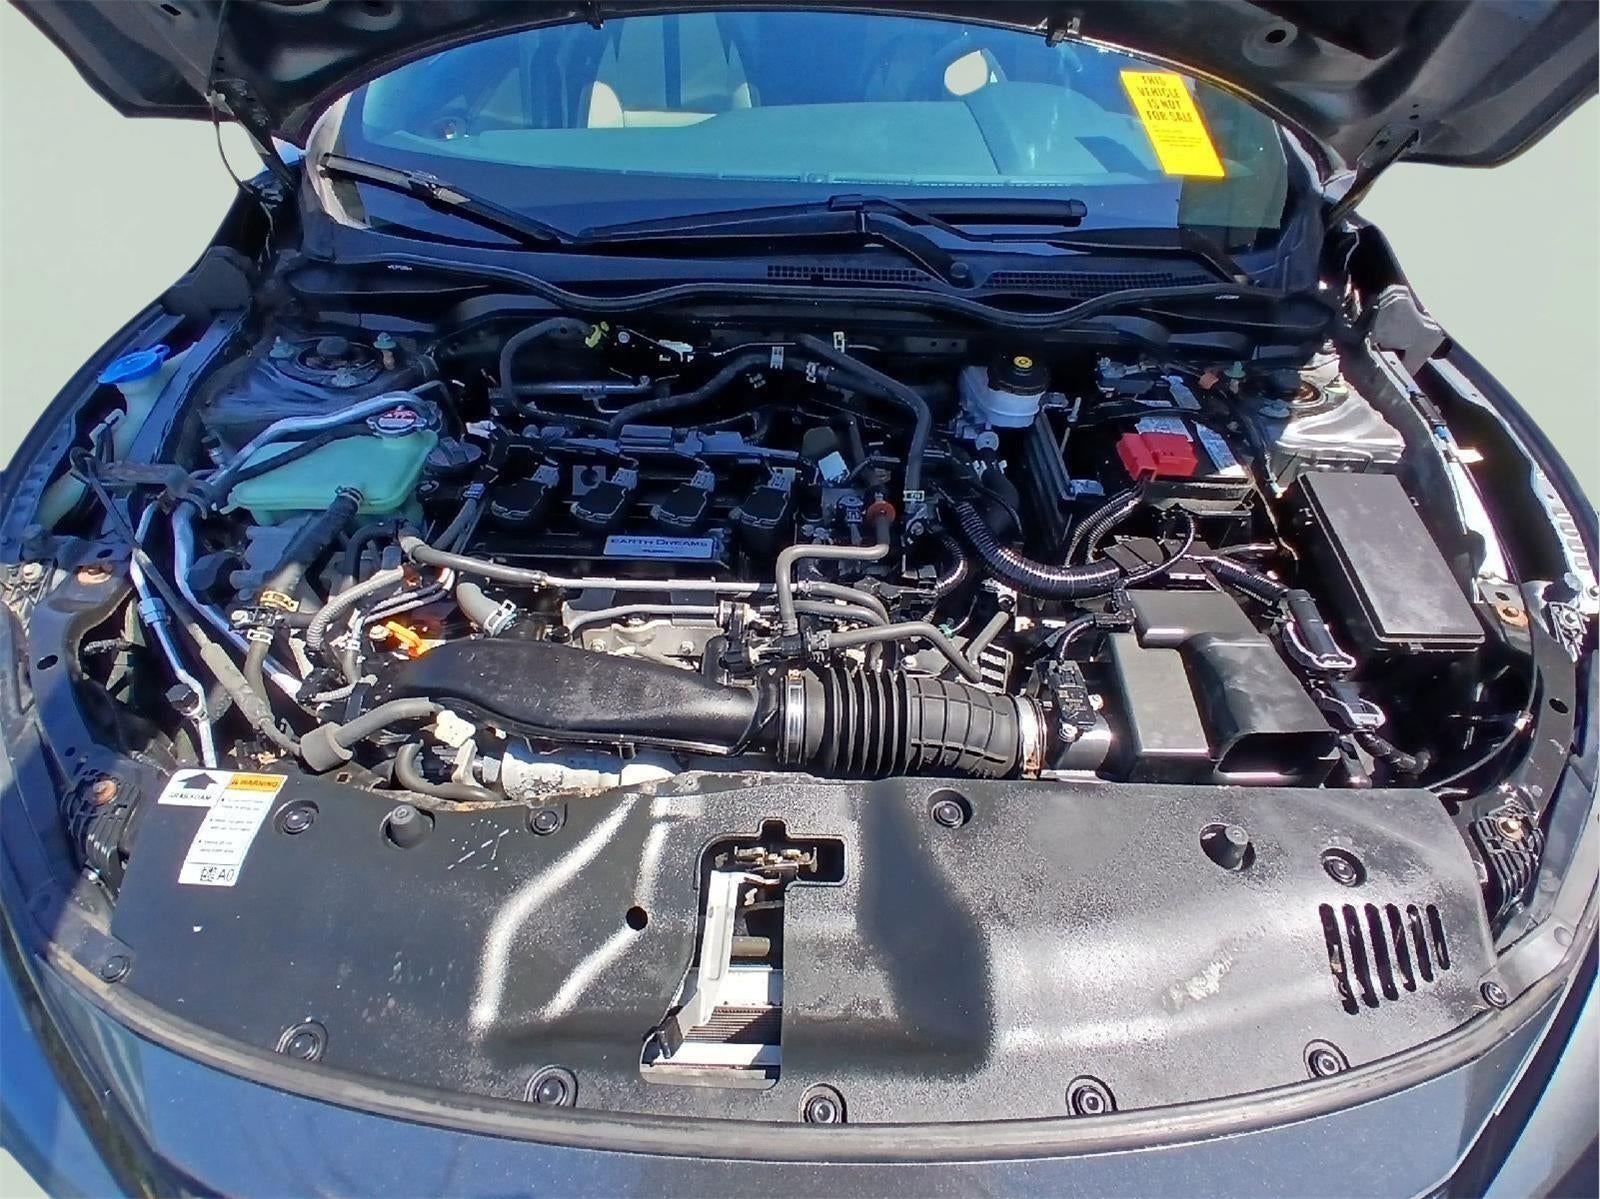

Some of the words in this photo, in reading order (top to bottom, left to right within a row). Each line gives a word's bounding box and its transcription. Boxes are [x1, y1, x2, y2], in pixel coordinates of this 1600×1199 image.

[1141, 75, 1166, 86] THIS
[1137, 87, 1180, 98] VEHICLE
[1147, 99, 1160, 109] IS
[1161, 100, 1181, 110] NOT
[1146, 110, 1167, 120] FOR
[1169, 111, 1194, 122] SALE
[239, 779, 279, 788] WARNING
